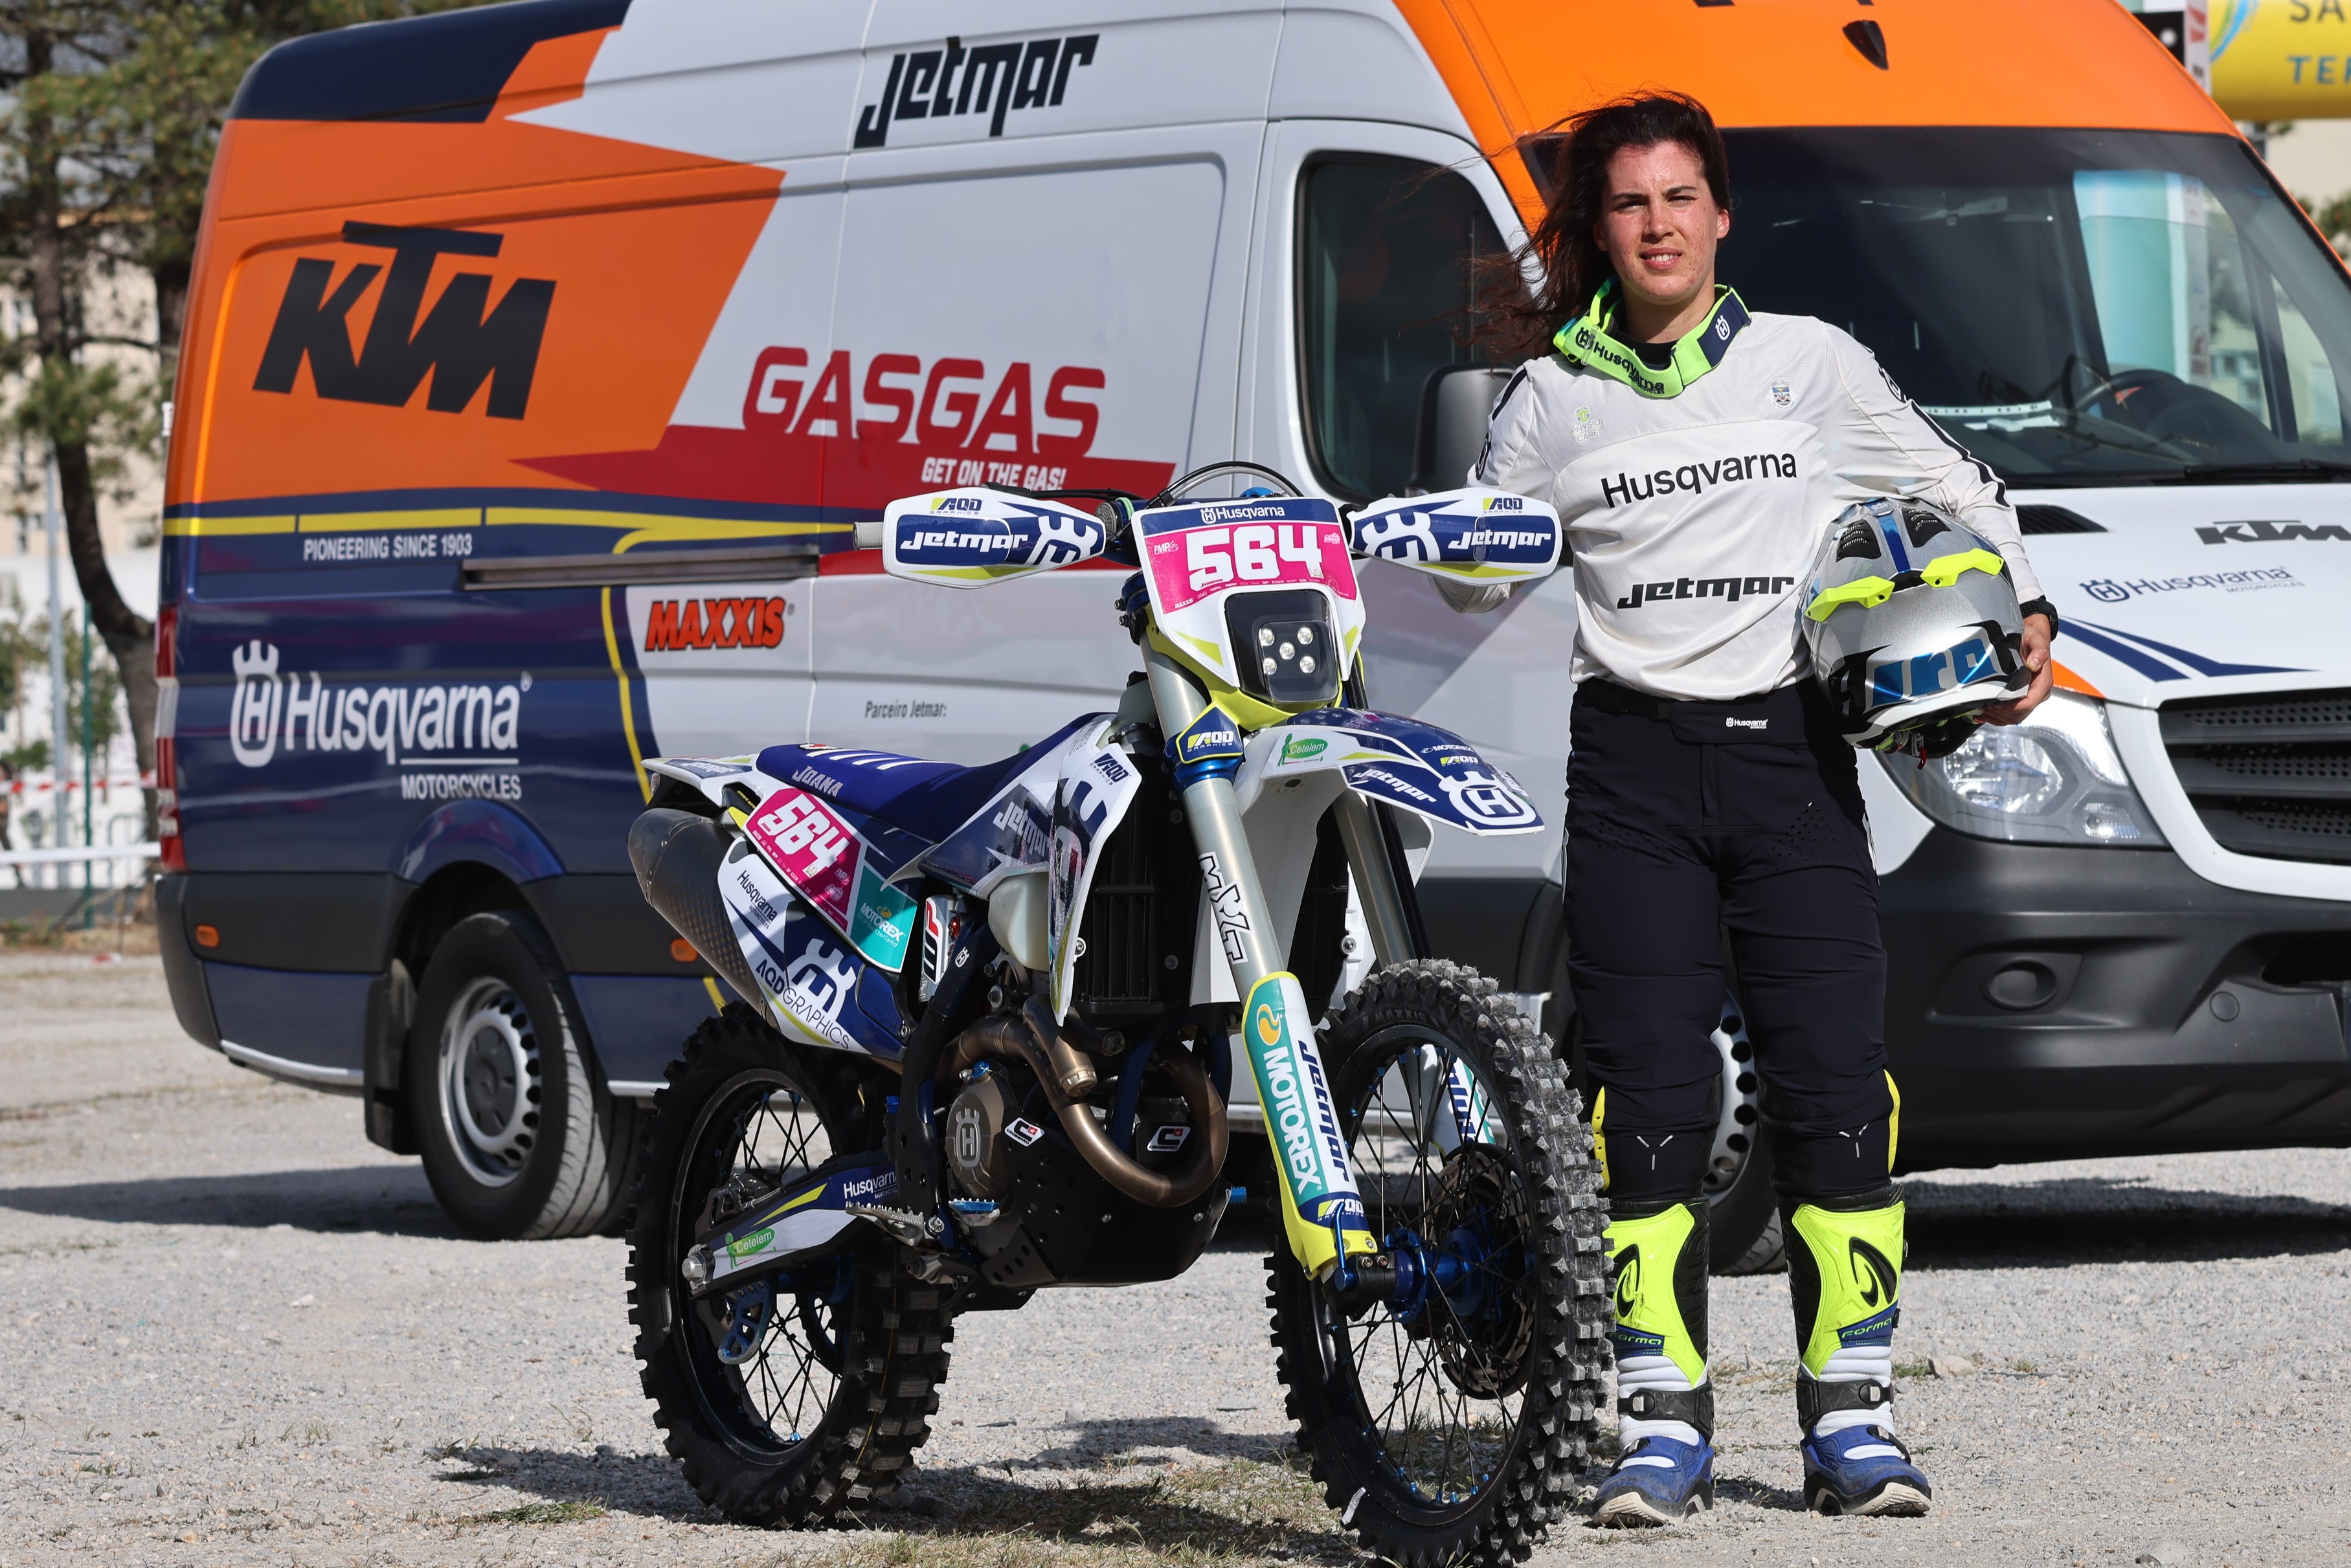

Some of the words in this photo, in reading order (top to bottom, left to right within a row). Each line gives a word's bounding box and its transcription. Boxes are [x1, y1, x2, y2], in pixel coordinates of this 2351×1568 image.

[251, 219, 557, 421] KTM
[1593, 341, 1665, 391] Husqvarna
[742, 345, 1107, 458] GASGAS
[1570, 418, 1601, 435] PHYSIO
[1576, 429, 1599, 443] CARE
[921, 456, 955, 484] GET
[957, 458, 982, 487] ON
[987, 461, 1021, 489] THE
[1024, 464, 1067, 491] GAS!
[1601, 452, 1797, 509] Husqvarna
[1217, 504, 1285, 521] Husqvarna
[2194, 520, 2351, 545] KTM
[304, 537, 388, 561] PIONEERING
[393, 535, 438, 559] SINCE
[441, 533, 473, 557] 1903
[1186, 524, 1325, 591] 564
[2126, 567, 2295, 595] Husqvarna
[1174, 598, 1194, 609] MAXXIS
[644, 595, 787, 653] MAXXIS
[286, 671, 518, 765] Husqvarna
[864, 700, 908, 719] Parceiro
[910, 700, 947, 719] Jetmar:
[1734, 719, 1767, 727] Husqvarna
[1290, 743, 1325, 754] Cetelem
[401, 774, 522, 801] MOTORCYCLES
[791, 765, 844, 798] JOANA
[757, 793, 850, 879] 564
[736, 869, 778, 923] Husqvarna
[748, 905, 771, 930] MOTORCYCLES
[860, 902, 905, 943] MOTOREX
[867, 922, 899, 948] Switzerland
[1375, 1009, 1427, 1024] MAXXIS
[1262, 1047, 1322, 1195] MOTOREX
[736, 1231, 772, 1253] Cetelem
